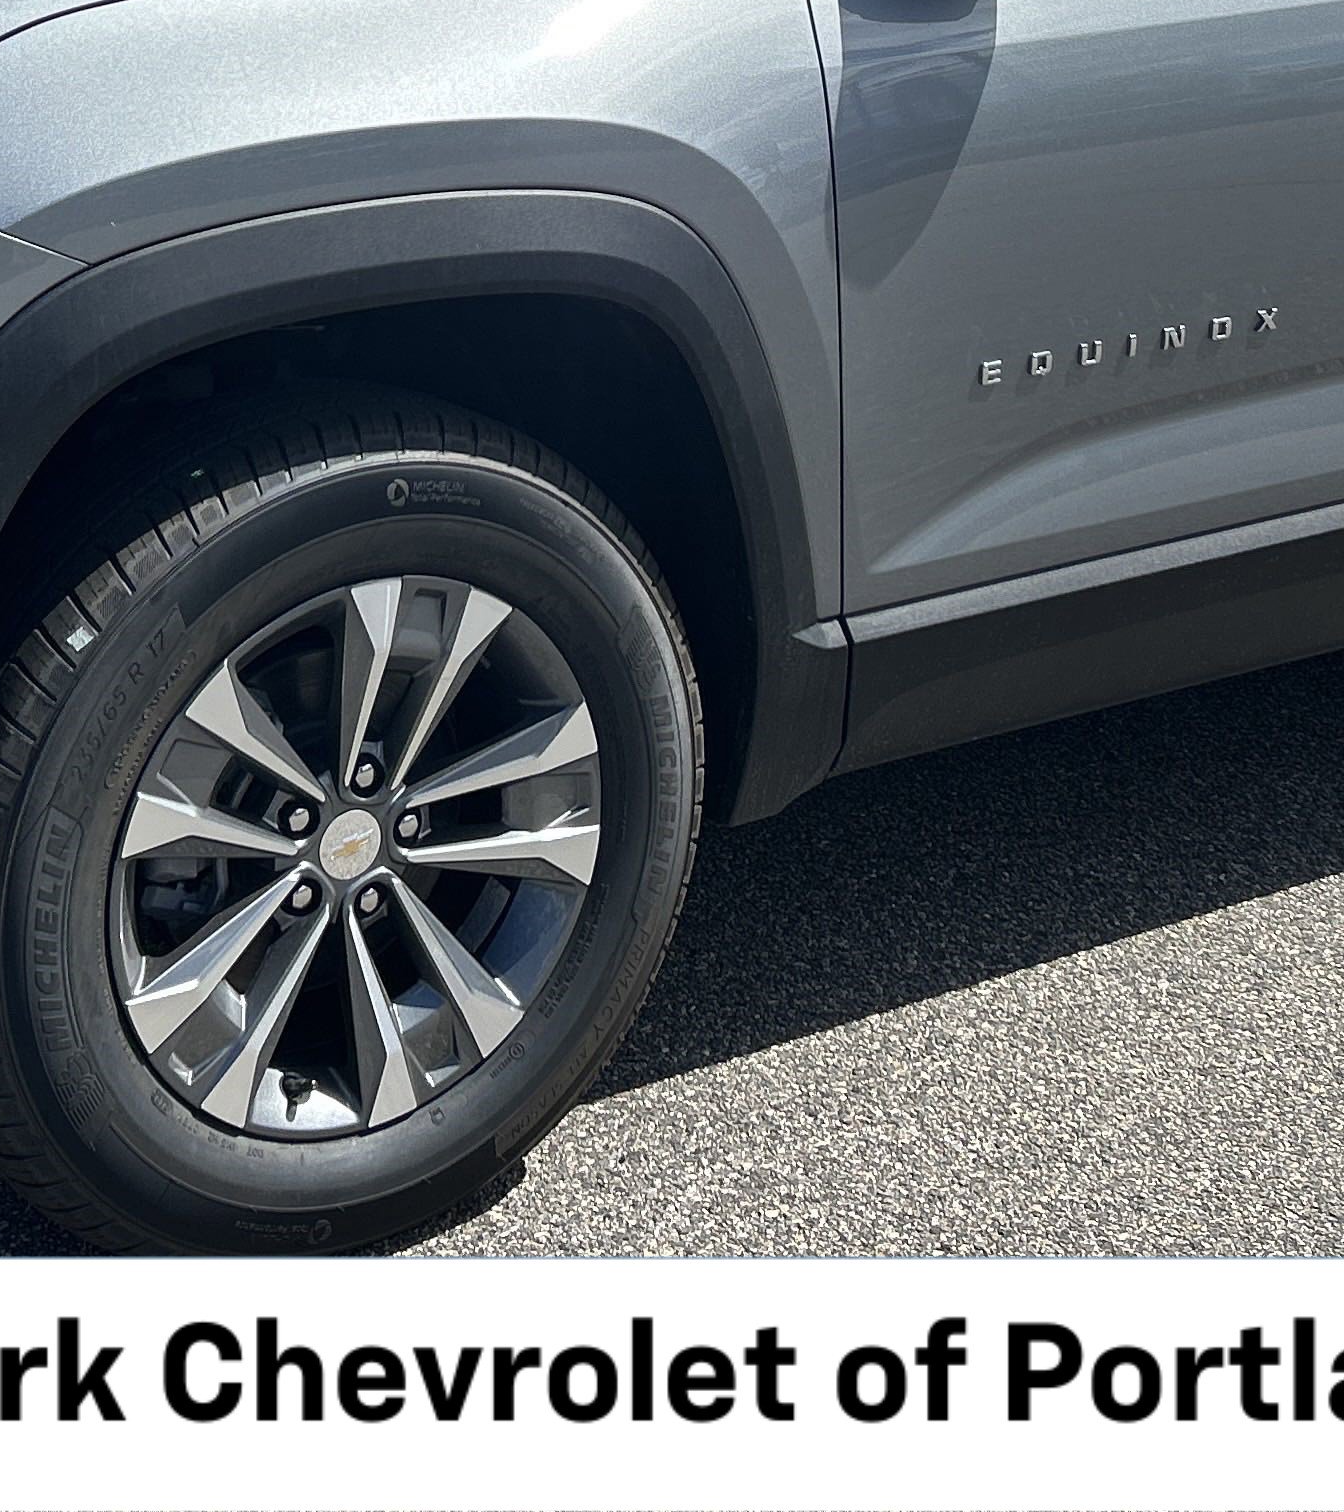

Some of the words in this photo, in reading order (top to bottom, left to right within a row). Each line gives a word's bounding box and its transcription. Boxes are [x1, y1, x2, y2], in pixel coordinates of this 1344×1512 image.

[978, 307, 1278, 386] EQUINOX
[646, 693, 679, 897] MICHELIN
[33, 813, 75, 1054] MICHELIN
[593, 926, 651, 1041] PRIMACY
